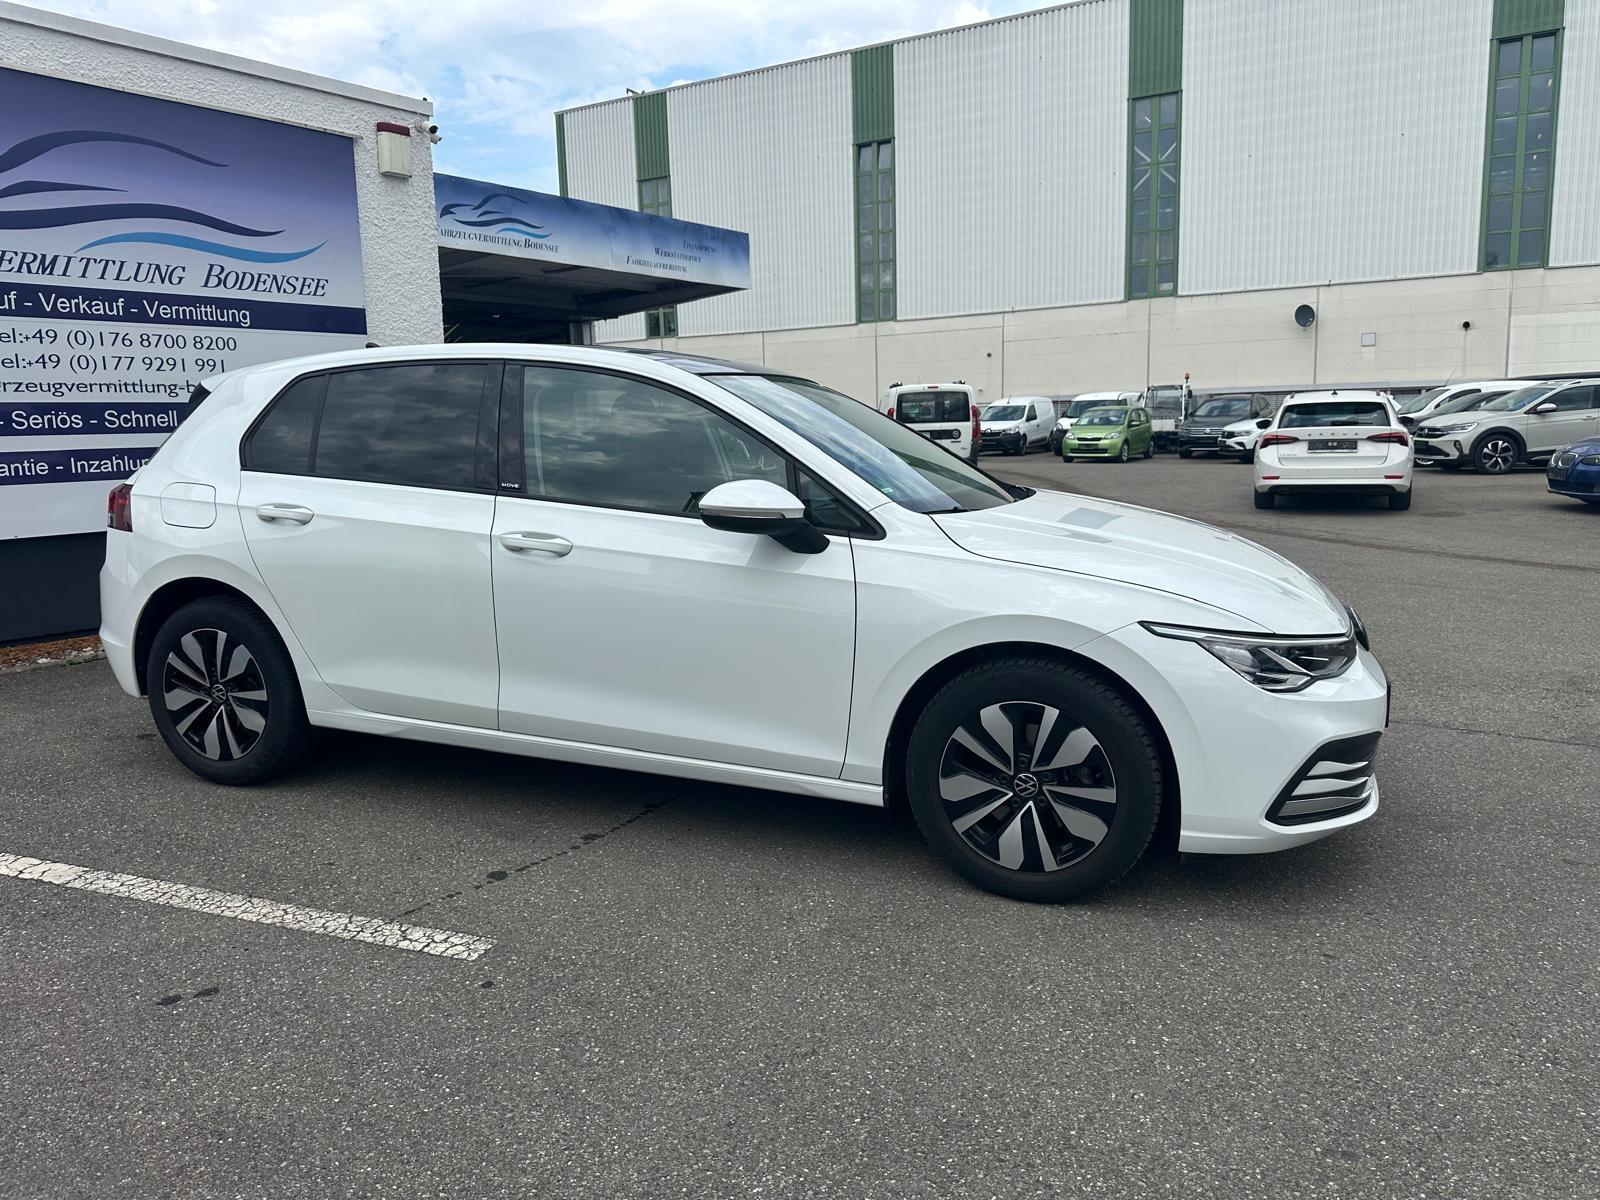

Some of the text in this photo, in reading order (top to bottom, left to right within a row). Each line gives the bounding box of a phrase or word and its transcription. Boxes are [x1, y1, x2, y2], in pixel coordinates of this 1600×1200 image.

[438, 228, 522, 248] AHRZEUGVERMITTLUNG
[0, 250, 329, 297] ERMITTLUNG BODENSEE
[38, 292, 125, 316] Verkauf
[143, 299, 250, 327] Vermittlung
[139, 333, 187, 350] 8700
[193, 335, 237, 351] 8200
[142, 356, 186, 372] 9291
[194, 358, 225, 373] 991
[0, 379, 197, 398] rzeugvermittlung-b
[11, 410, 83, 430] Seriös
[104, 409, 179, 428] Schnell
[0, 458, 49, 477] antie
